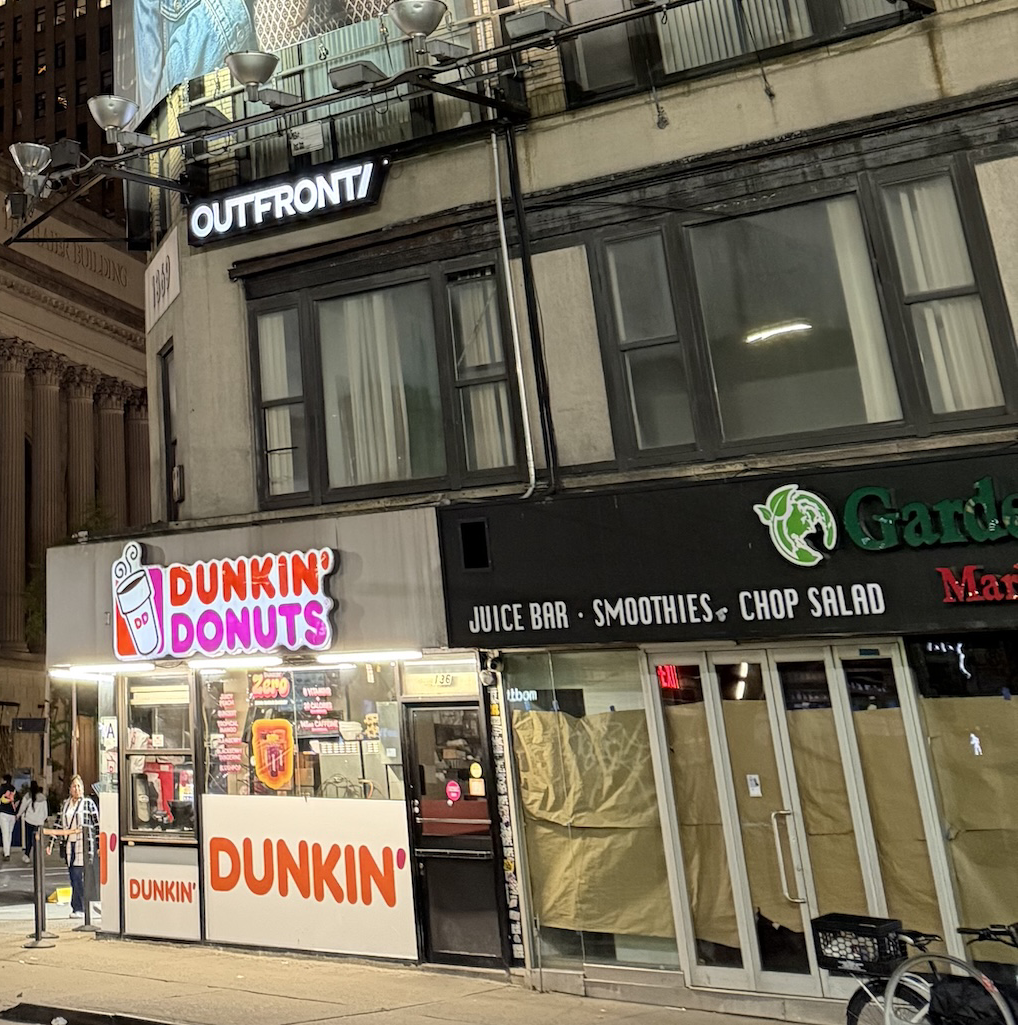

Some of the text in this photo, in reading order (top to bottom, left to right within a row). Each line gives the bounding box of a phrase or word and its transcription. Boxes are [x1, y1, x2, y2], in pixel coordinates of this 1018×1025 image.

[73, 239, 128, 288] BUILDING
[152, 254, 170, 309] 1369
[170, 550, 330, 607] DUNKIN'
[134, 612, 149, 629] DD
[171, 600, 327, 653] DONUTS
[469, 582, 886, 633] JUICE BAR SMOOTHIES CHOP SALAD
[252, 673, 290, 699] Zero
[435, 674, 451, 685] 136
[106, 722, 115, 739] A
[129, 878, 196, 904] DUNKIN'
[210, 837, 406, 908] DUNKIN'
